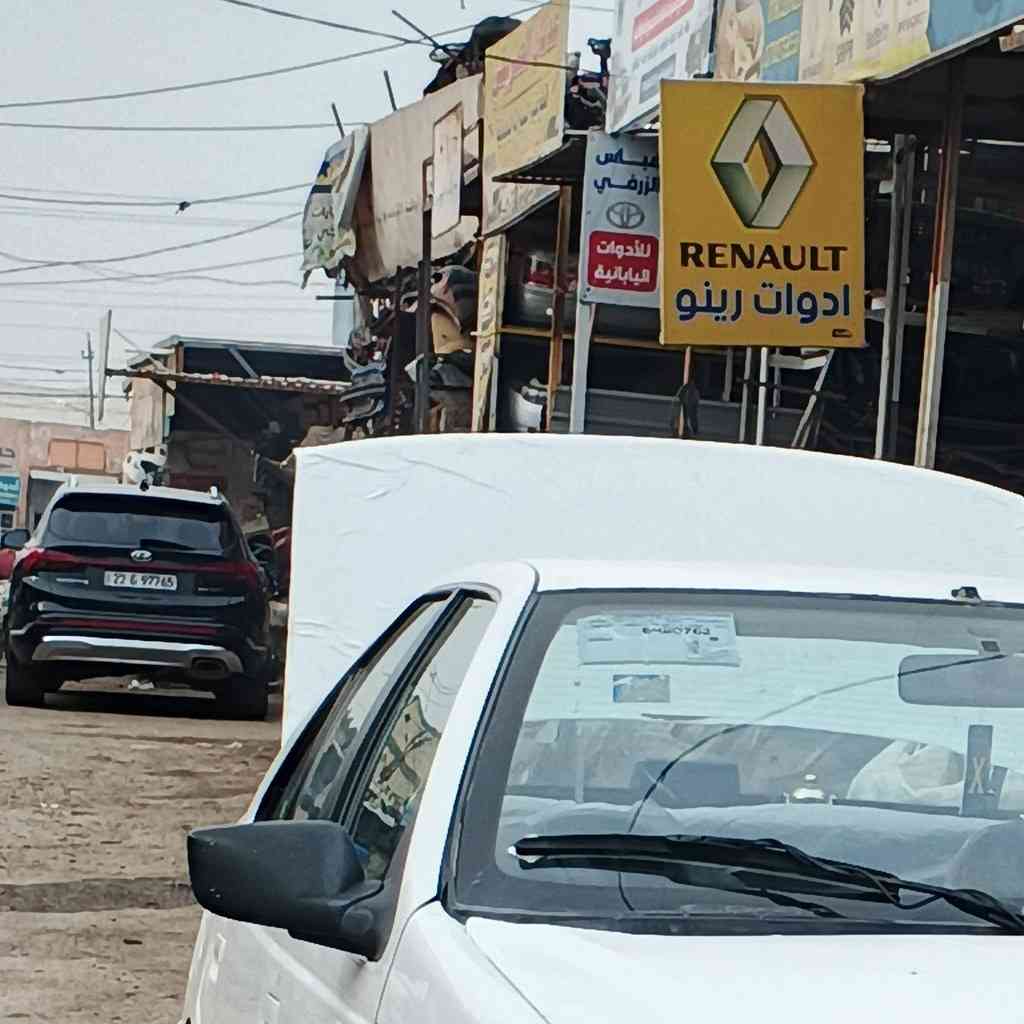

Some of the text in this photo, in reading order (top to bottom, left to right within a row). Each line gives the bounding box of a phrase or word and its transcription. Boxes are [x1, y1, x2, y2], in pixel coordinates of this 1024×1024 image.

[679, 241, 849, 272] RENAULT
[675, 280, 850, 325] ادوات رينو
